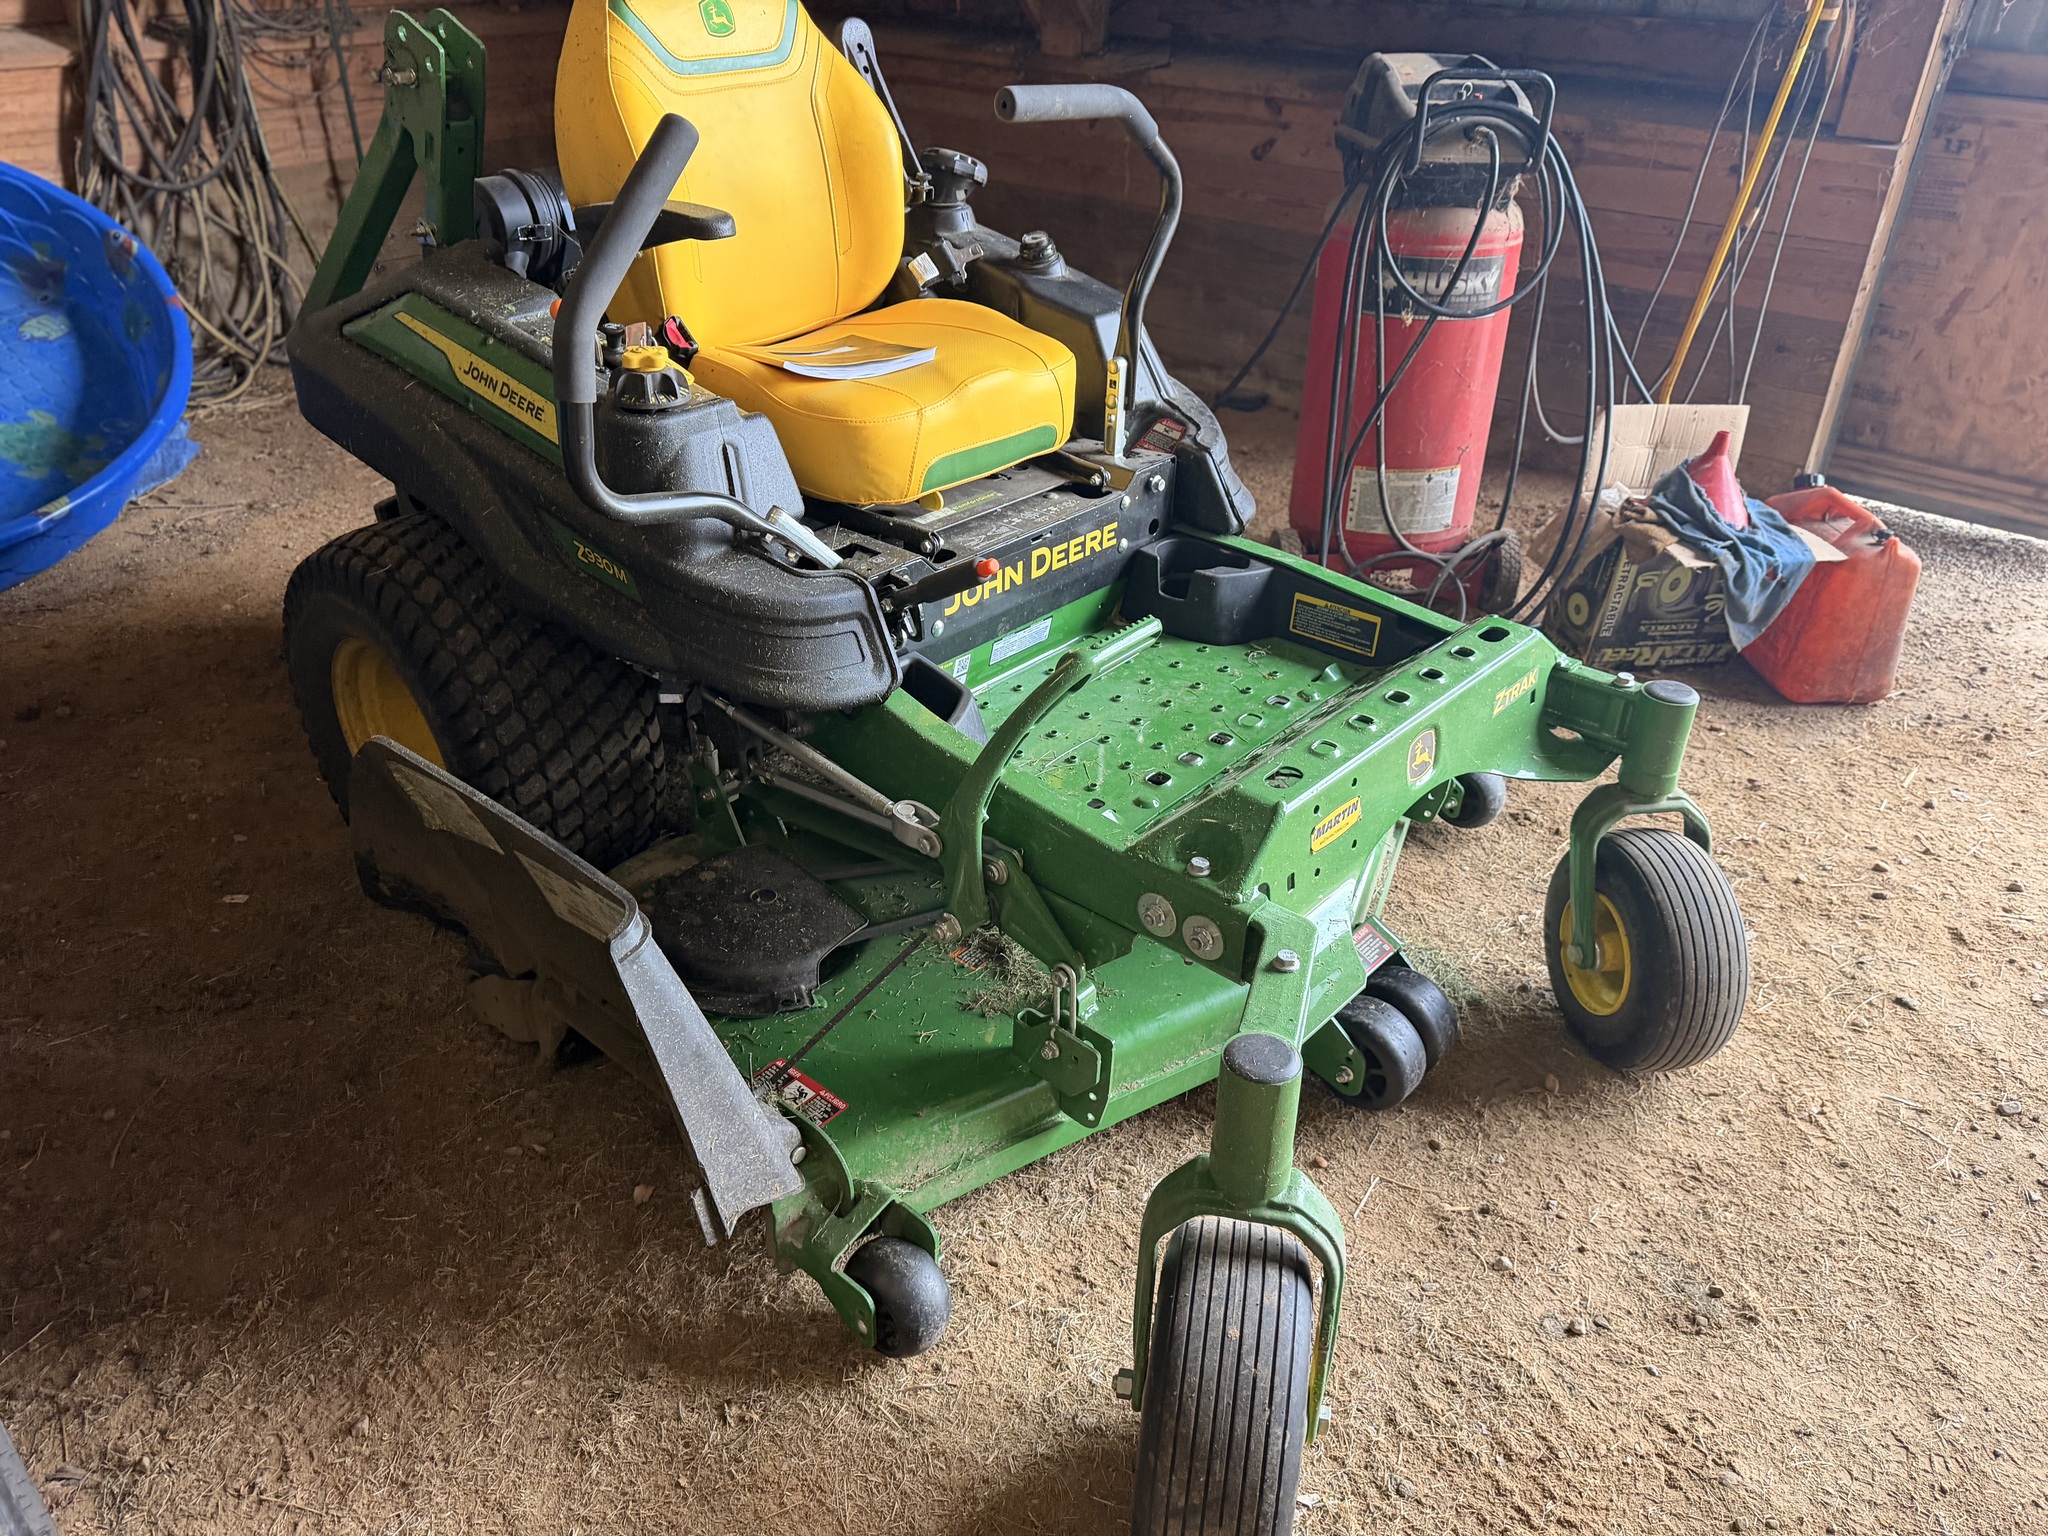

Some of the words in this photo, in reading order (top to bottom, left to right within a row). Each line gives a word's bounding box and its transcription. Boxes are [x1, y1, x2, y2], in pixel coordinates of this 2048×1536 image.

[1403, 265, 1501, 296] HUSKY
[463, 361, 498, 393] JOHN
[499, 381, 545, 422] DEERE
[573, 540, 628, 584] Z930M
[944, 560, 1023, 617] JOHN
[1031, 521, 1118, 580] DEERE
[1600, 556, 1632, 638] ETRACTABLE
[1493, 667, 1538, 716] ZTRAK
[1315, 799, 1359, 840] MARTIN
[824, 1091, 846, 1110] PELIGRO
